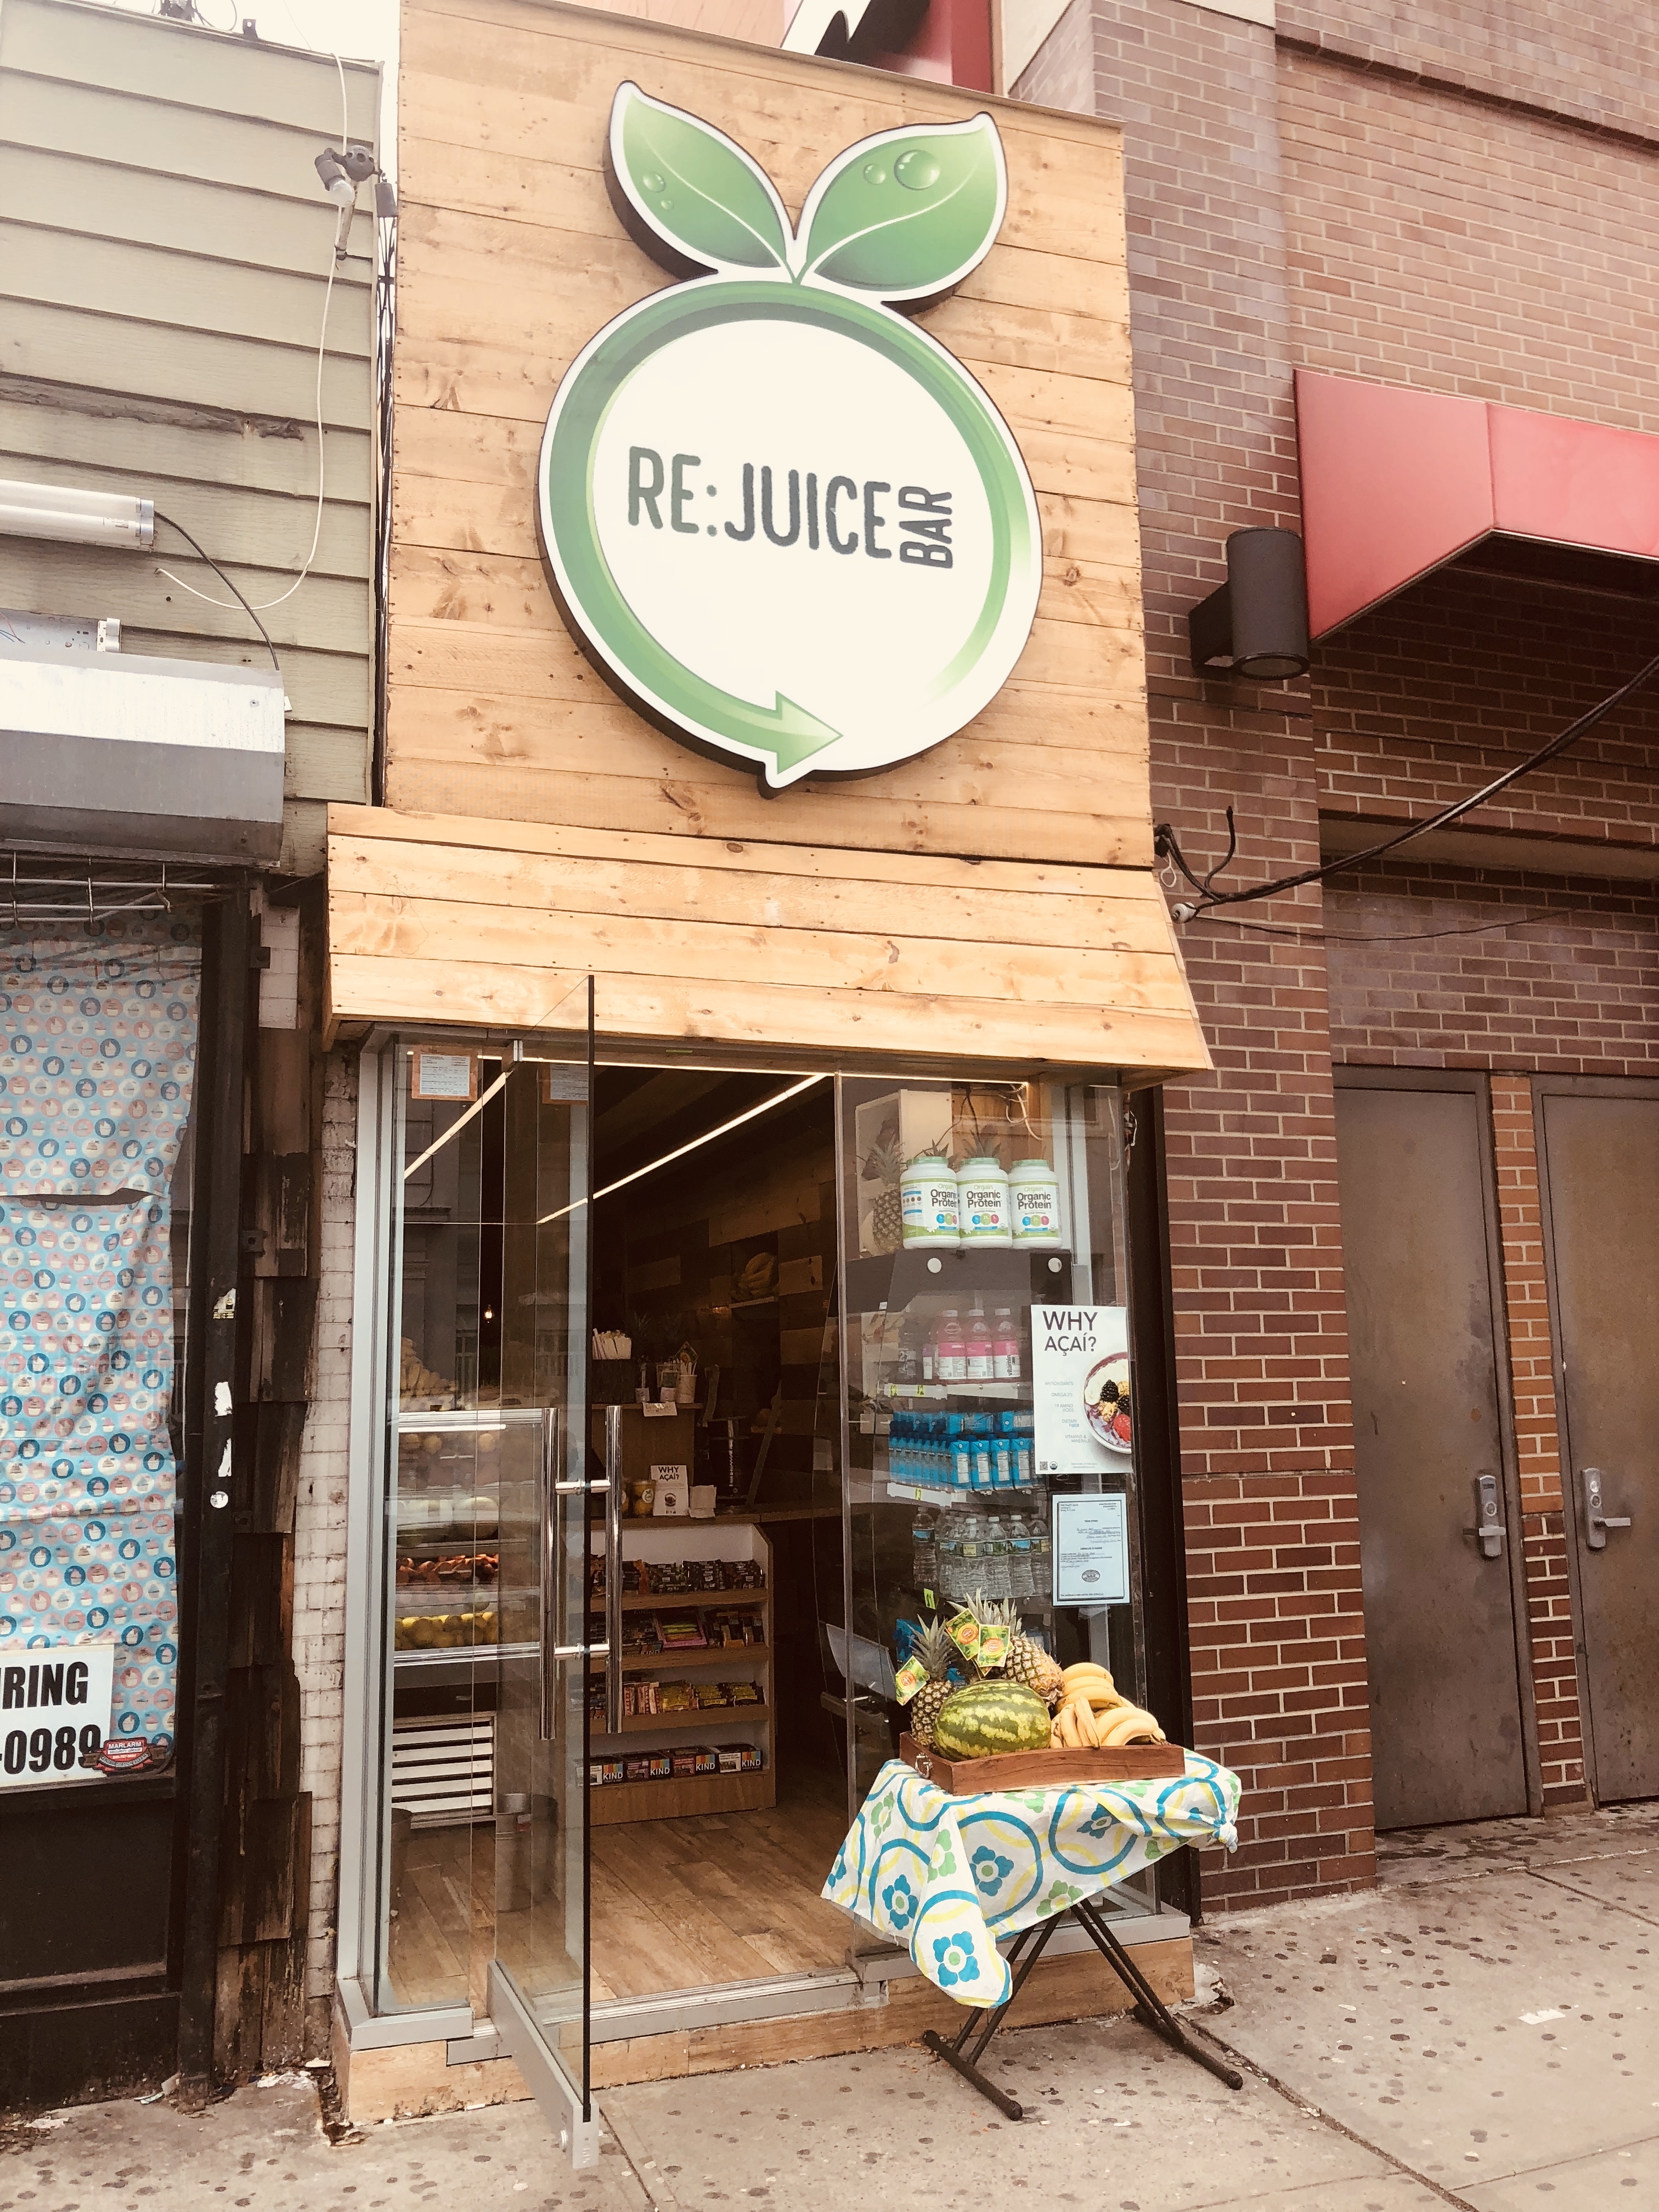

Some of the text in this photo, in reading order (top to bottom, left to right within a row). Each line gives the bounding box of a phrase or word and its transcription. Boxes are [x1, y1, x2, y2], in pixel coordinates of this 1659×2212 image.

[898, 486, 953, 569] BAR
[967, 1190, 1001, 1200] Organic
[1017, 1192, 1051, 1202] Organic
[968, 1199, 1001, 1208] Protein
[1018, 1201, 1052, 1210] Protein
[1042, 1311, 1098, 1331] WHY
[1044, 1333, 1097, 1356] AÇAÍ?
[659, 1473, 680, 1481] AÇAÍ?
[0, 1661, 89, 1709] RING
[108, 1741, 142, 1750] MARLARM
[696, 1763, 715, 1771] KIND
[742, 1759, 761, 1768] KIND
[650, 1767, 670, 1776] KIND
[603, 1772, 623, 1781] KIND
